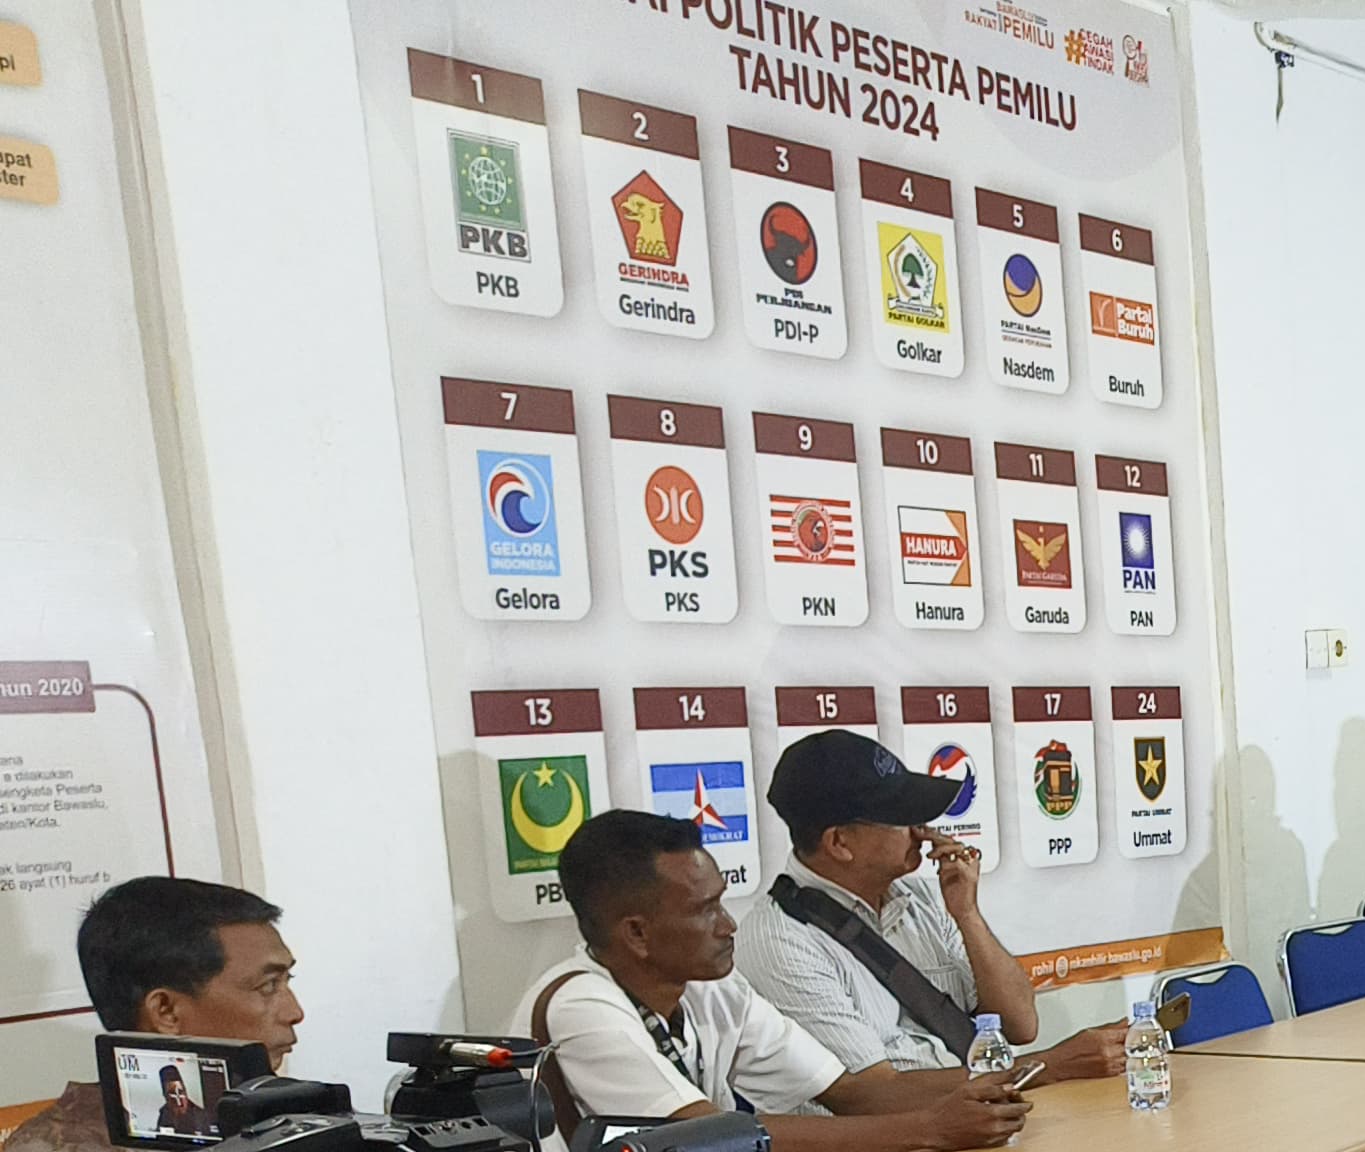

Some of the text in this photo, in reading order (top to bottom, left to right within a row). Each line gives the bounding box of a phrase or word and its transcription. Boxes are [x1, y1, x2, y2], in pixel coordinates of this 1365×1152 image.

[964, 10, 998, 31] RAKYAT
[1003, 16, 1055, 50] PEMILU
[1080, 28, 1113, 47] CEGAH
[832, 21, 971, 101] PESERTA
[977, 65, 1078, 131] PEMILU
[471, 74, 484, 103] 1
[728, 44, 940, 141] TAHUN 2024
[632, 112, 649, 140] 2
[775, 146, 789, 173] 3
[900, 177, 914, 202] 4
[1012, 204, 1024, 228] 5
[460, 224, 529, 259] PKB
[1111, 228, 1123, 252] 6
[475, 271, 520, 299] PKB
[618, 262, 690, 287] GERINDRA
[618, 293, 697, 326] Gerindra
[1116, 302, 1153, 324] Partai
[773, 318, 820, 345] PDI-P
[1117, 319, 1154, 340] Buruh
[896, 339, 943, 364] Golkar
[1002, 356, 1055, 384] Nasdem
[1108, 375, 1145, 398] Buruh
[500, 392, 518, 420] 7
[660, 409, 677, 436] 8
[798, 425, 813, 451] 9
[916, 439, 938, 465] 10
[1029, 453, 1044, 477] 11
[1124, 465, 1142, 488] 12
[490, 541, 554, 558] GELORA
[905, 536, 958, 558] HANURA
[491, 558, 556, 571] INDONESIA
[648, 548, 709, 578] PKS
[1122, 569, 1156, 591] PAN
[495, 587, 561, 611] Gelora
[665, 592, 700, 613] PKS
[802, 597, 836, 618] PKN
[915, 601, 965, 622] Hanura
[1025, 606, 1070, 626] Garuda
[1130, 610, 1154, 628] PAN
[38, 677, 83, 697] 2020
[524, 697, 553, 727] 13
[679, 695, 706, 722] 14
[816, 693, 838, 719] 15
[936, 693, 957, 718] 16
[1044, 693, 1062, 716] 17
[1137, 692, 1157, 714] 24
[1046, 799, 1073, 813] PPP
[702, 830, 744, 842] EMOKRAT
[1048, 837, 1072, 856] PPP
[1133, 829, 1172, 848] Ummat
[535, 882, 563, 905] PB
